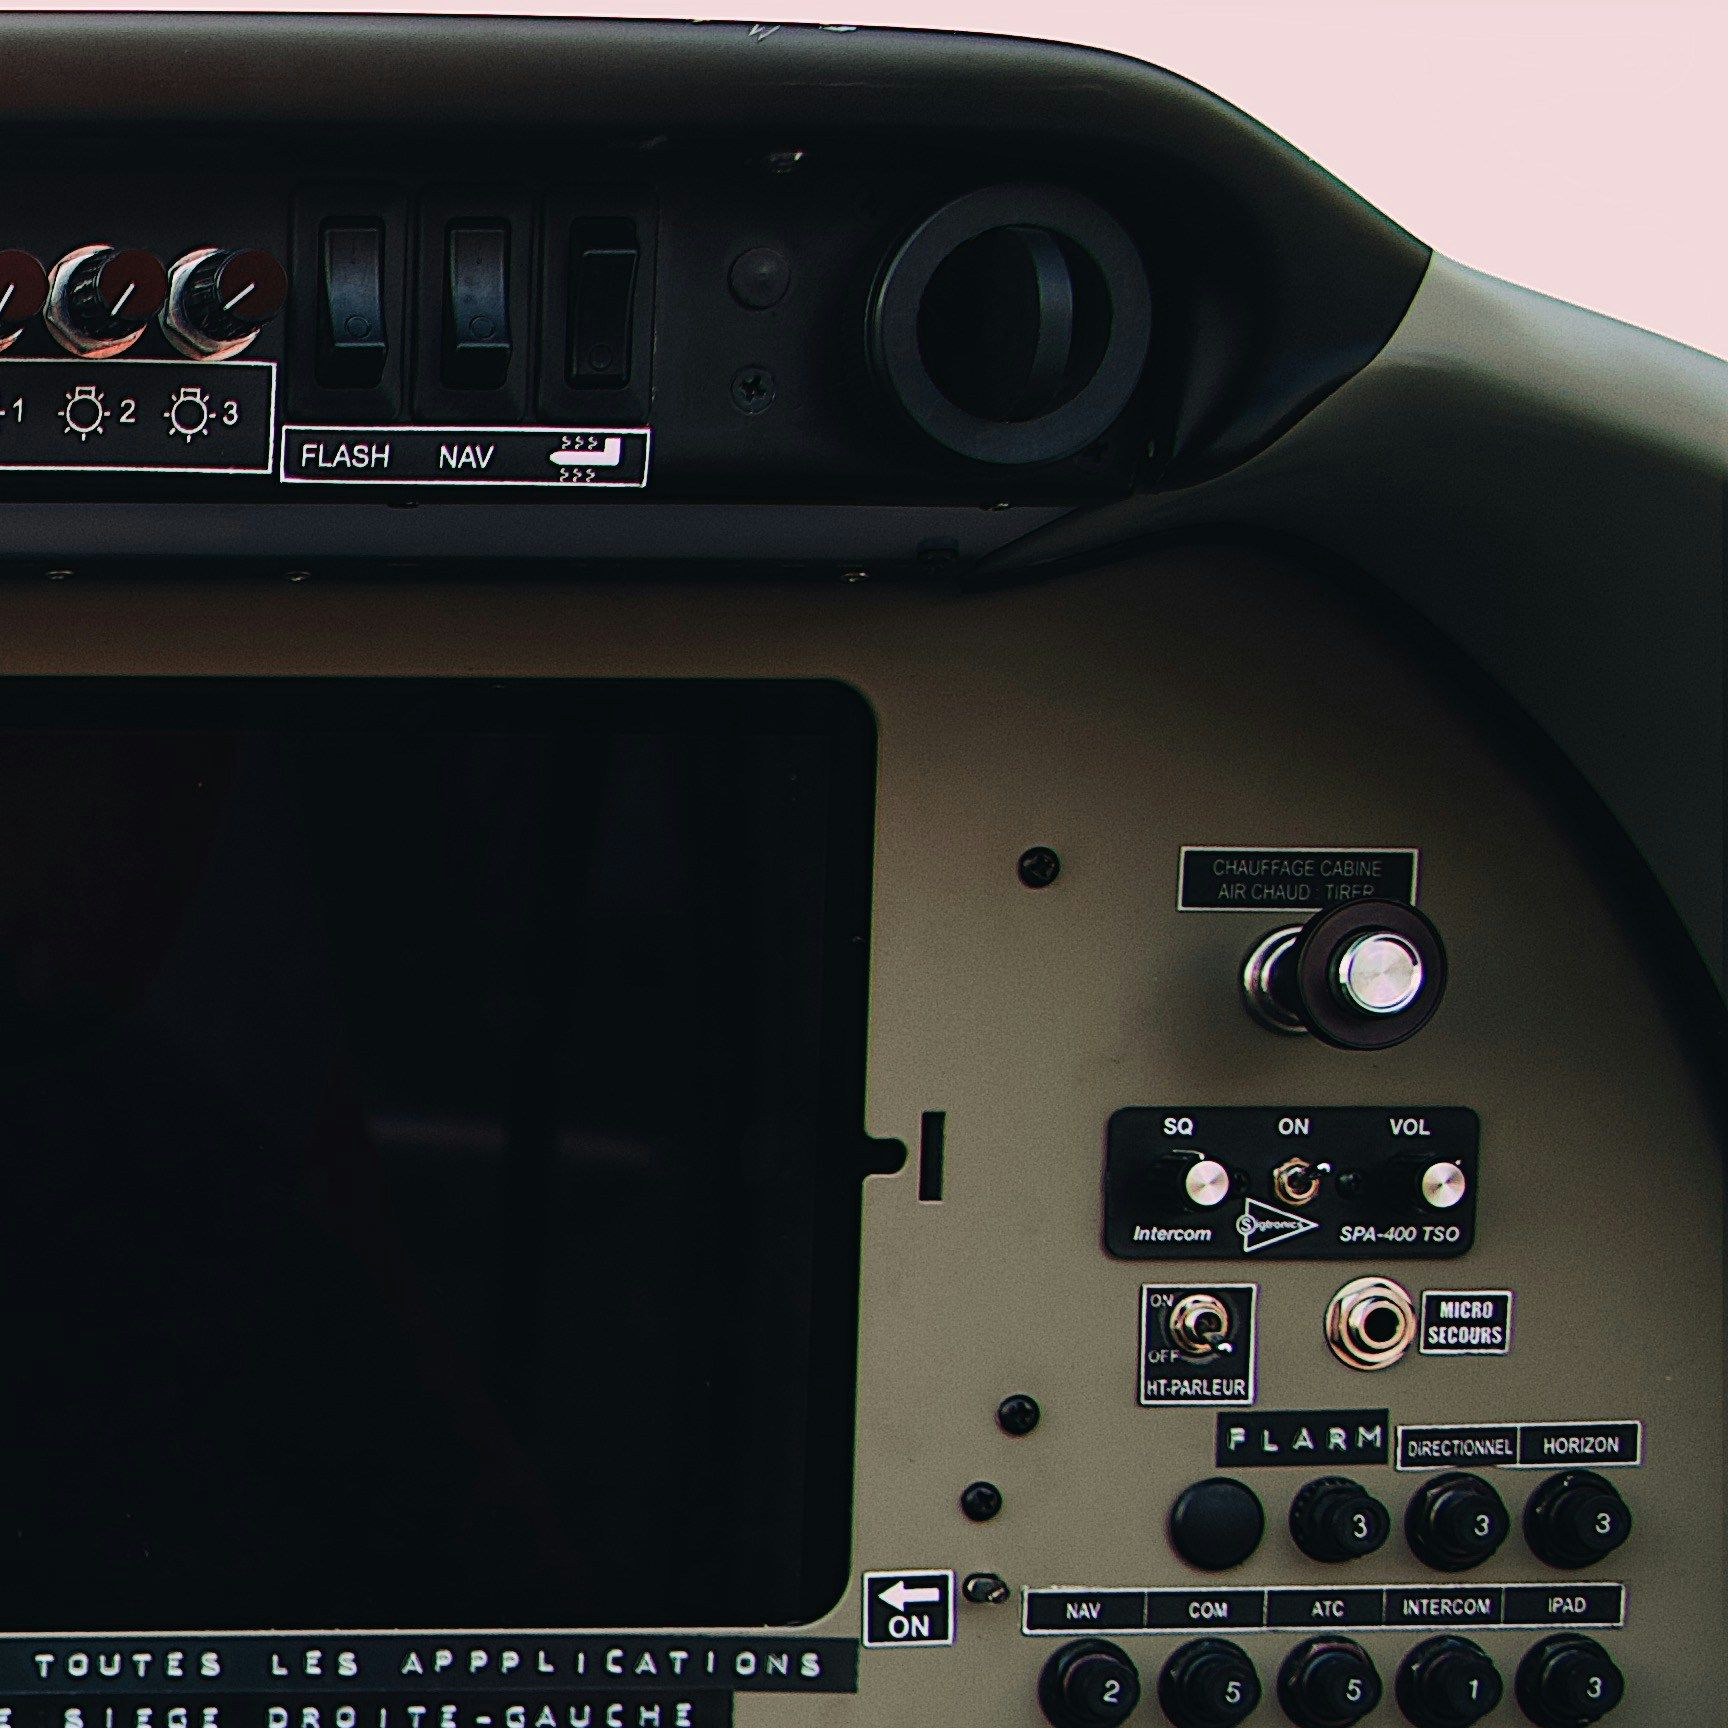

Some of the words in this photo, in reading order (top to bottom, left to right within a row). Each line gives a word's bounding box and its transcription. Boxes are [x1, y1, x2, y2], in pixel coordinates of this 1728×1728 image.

[302, 444, 389, 467] FLASH
[440, 446, 494, 467] NAV
[1214, 860, 1315, 876] CHAUFFAGE
[1320, 862, 1382, 877] CABINE
[1219, 883, 1245, 899] AIR
[1251, 883, 1310, 899] CHAUD
[1164, 1119, 1193, 1135] SQ
[1279, 1118, 1309, 1134] ON
[1390, 1120, 1430, 1135] VOL
[1134, 1226, 1211, 1242] Intercom
[1341, 1227, 1417, 1242] SPA-400
[1423, 1227, 1459, 1241] TSO
[1441, 1302, 1493, 1319] MICRO
[1429, 1327, 1502, 1344] SECOURS
[1228, 1426, 1381, 1452] FLARM
[1408, 1436, 1512, 1457] DIRECTIONNEL
[1544, 1436, 1618, 1455] HORIZON
[1067, 1602, 1101, 1619] NAV
[1189, 1601, 1227, 1618] COM
[1312, 1599, 1344, 1617] ATC
[1403, 1598, 1490, 1616] INTERCOM
[1548, 1597, 1586, 1614] IPAD
[888, 1616, 928, 1637] ON
[35, 1654, 220, 1677] TOUTES
[273, 1652, 357, 1676] LES
[403, 1650, 821, 1677] APPPLICATIONS
